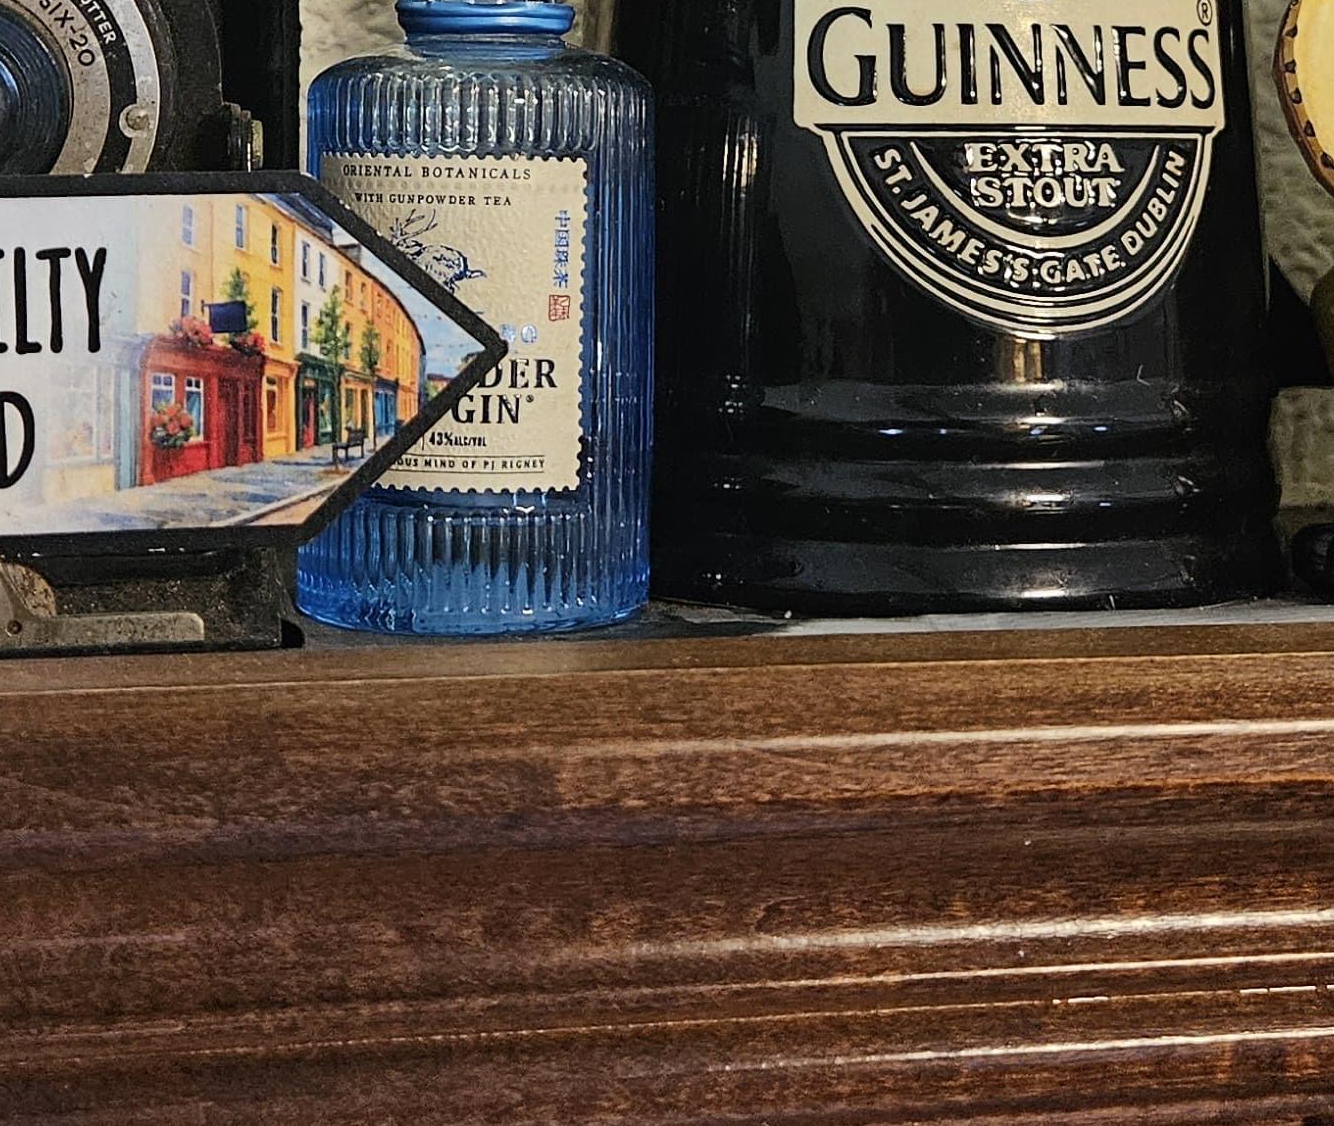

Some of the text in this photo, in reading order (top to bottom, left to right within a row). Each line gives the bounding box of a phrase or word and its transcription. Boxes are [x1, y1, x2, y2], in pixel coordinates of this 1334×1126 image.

[966, 141, 1125, 174] EXTRA
[343, 164, 531, 180] ORIENTAL BOTANICALS
[354, 192, 512, 206] WITH GUNPOWDER TEA
[874, 147, 903, 194] ST.
[1122, 151, 1186, 256] DUBLIN
[970, 177, 1119, 209] STOUT
[424, 459, 455, 468] MIND
[462, 460, 476, 469] OF
[483, 461, 495, 470] PJ
[501, 459, 545, 469] RIGNEY
